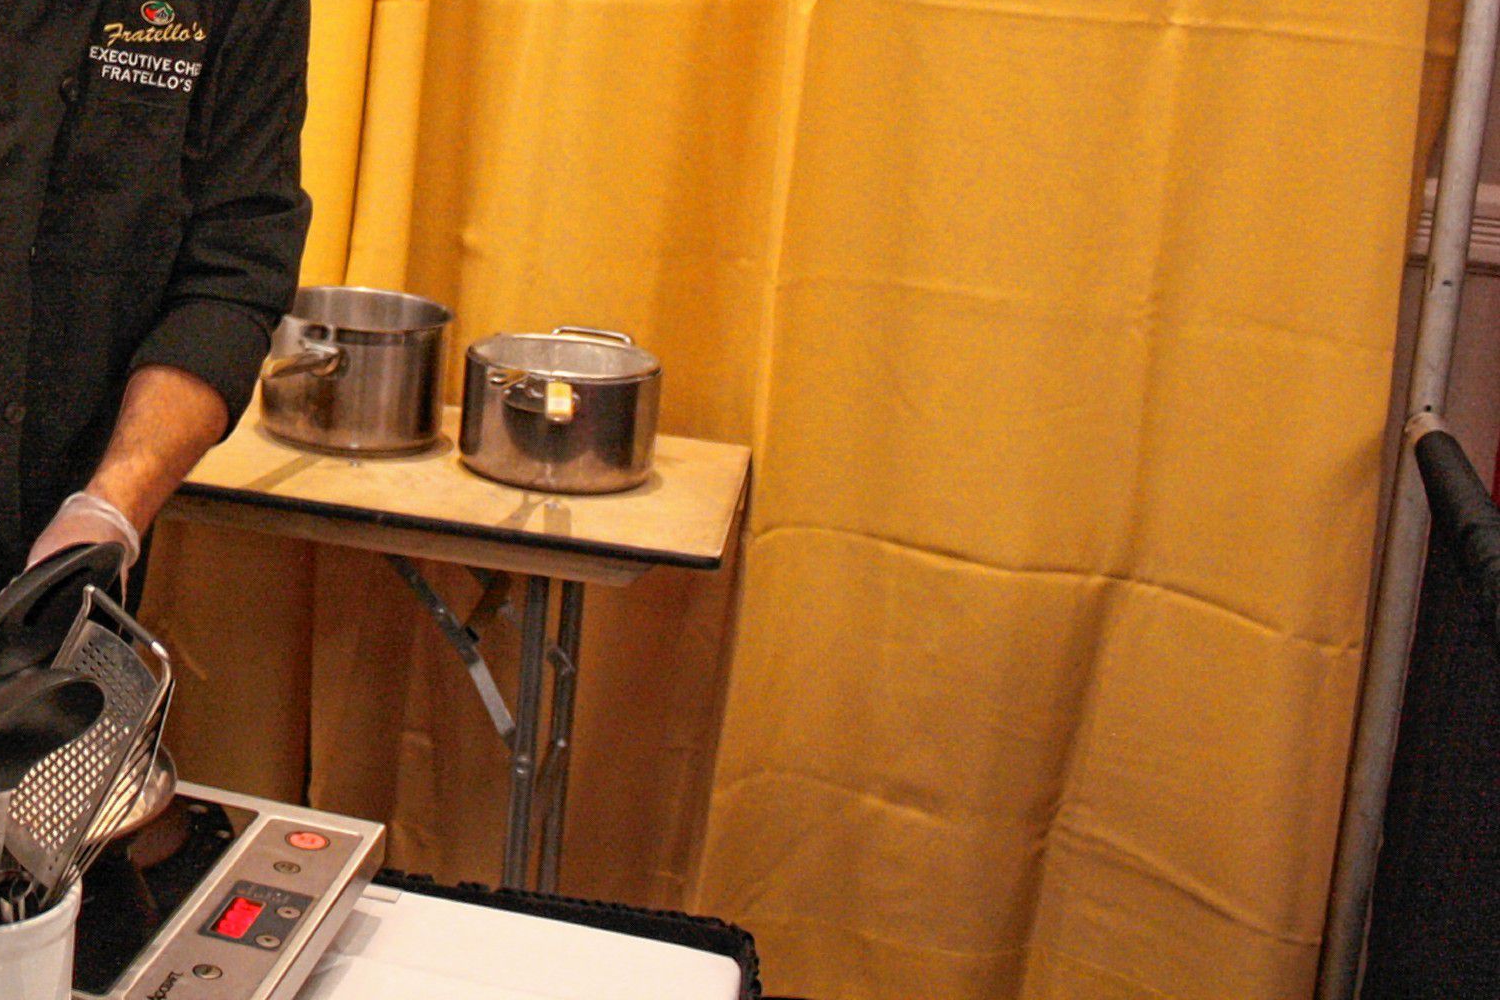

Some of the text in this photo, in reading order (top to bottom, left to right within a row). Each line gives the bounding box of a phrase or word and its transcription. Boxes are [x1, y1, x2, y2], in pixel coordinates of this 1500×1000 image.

[103, 21, 207, 47] Fratello's
[88, 45, 172, 72] EXECUTIVE
[101, 64, 194, 92] FRATELLO'S
